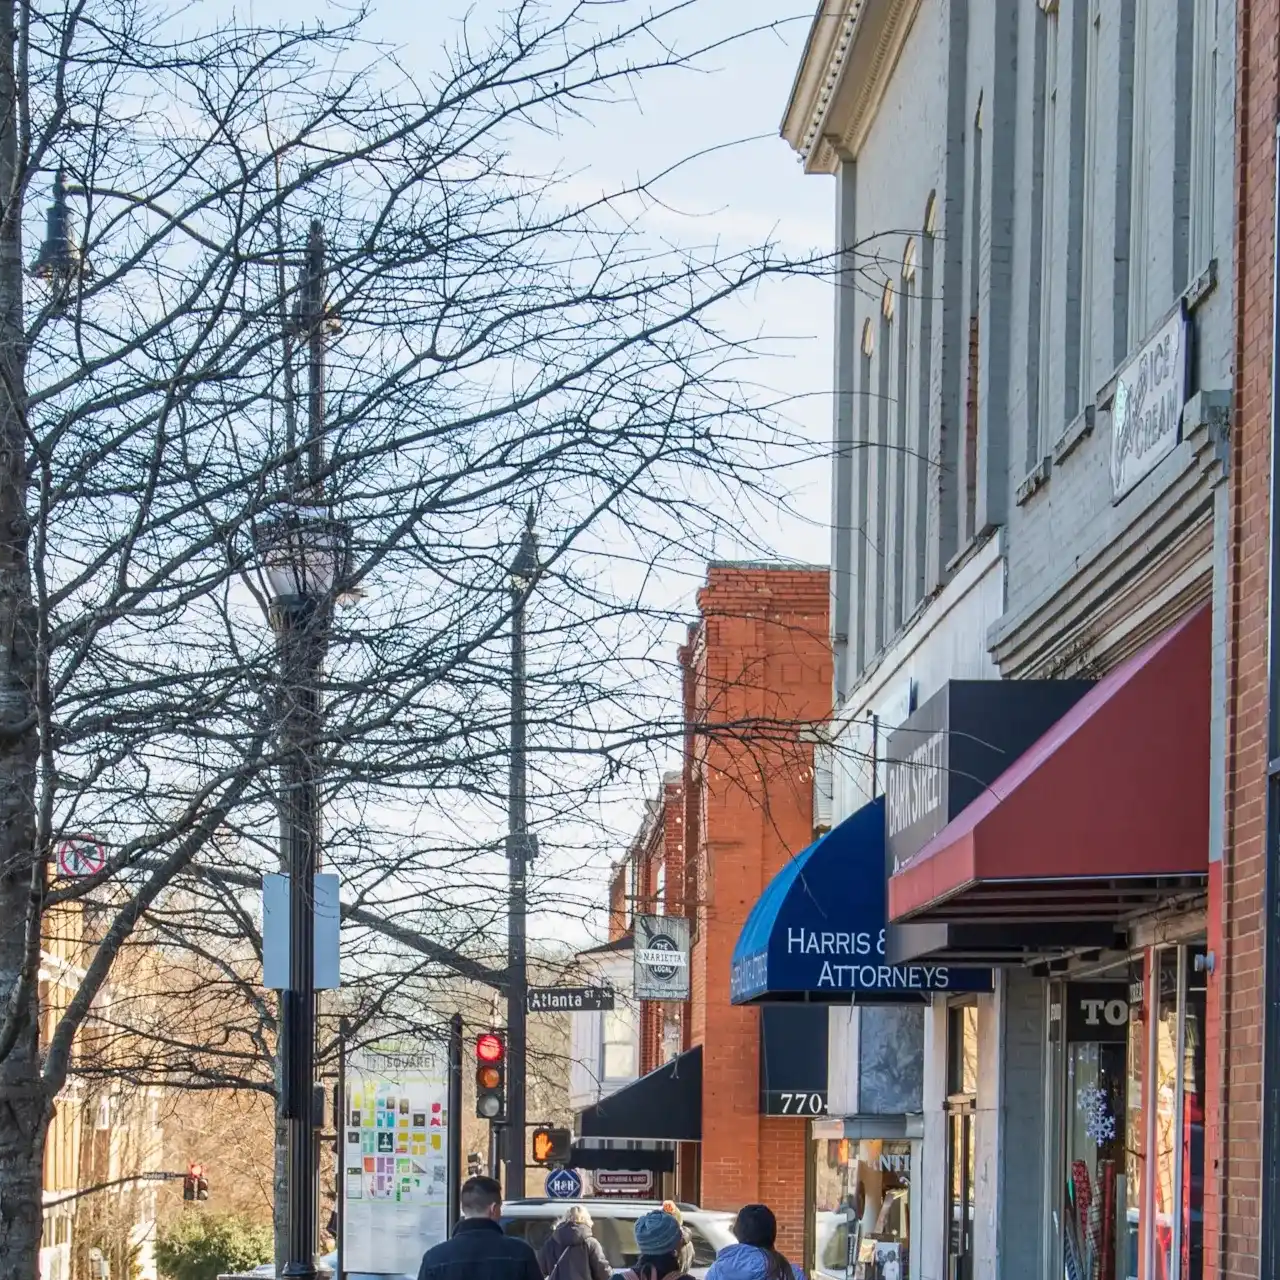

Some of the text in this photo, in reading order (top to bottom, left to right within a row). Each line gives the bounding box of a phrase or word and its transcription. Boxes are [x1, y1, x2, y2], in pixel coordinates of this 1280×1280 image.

[1149, 333, 1171, 393] ICE
[1133, 382, 1179, 460] CREAM
[888, 728, 945, 838] BARK STREET
[655, 943, 669, 951] THE
[787, 927, 871, 955] HARRIS
[643, 951, 683, 964] MARIETTA
[653, 965, 672, 974] LOCAL
[817, 960, 949, 989] ATTORNEYS
[531, 992, 582, 1008] Atlanta
[584, 990, 594, 998] ST
[386, 1056, 431, 1069] SQUARE
[553, 1180, 574, 1191] H&H
